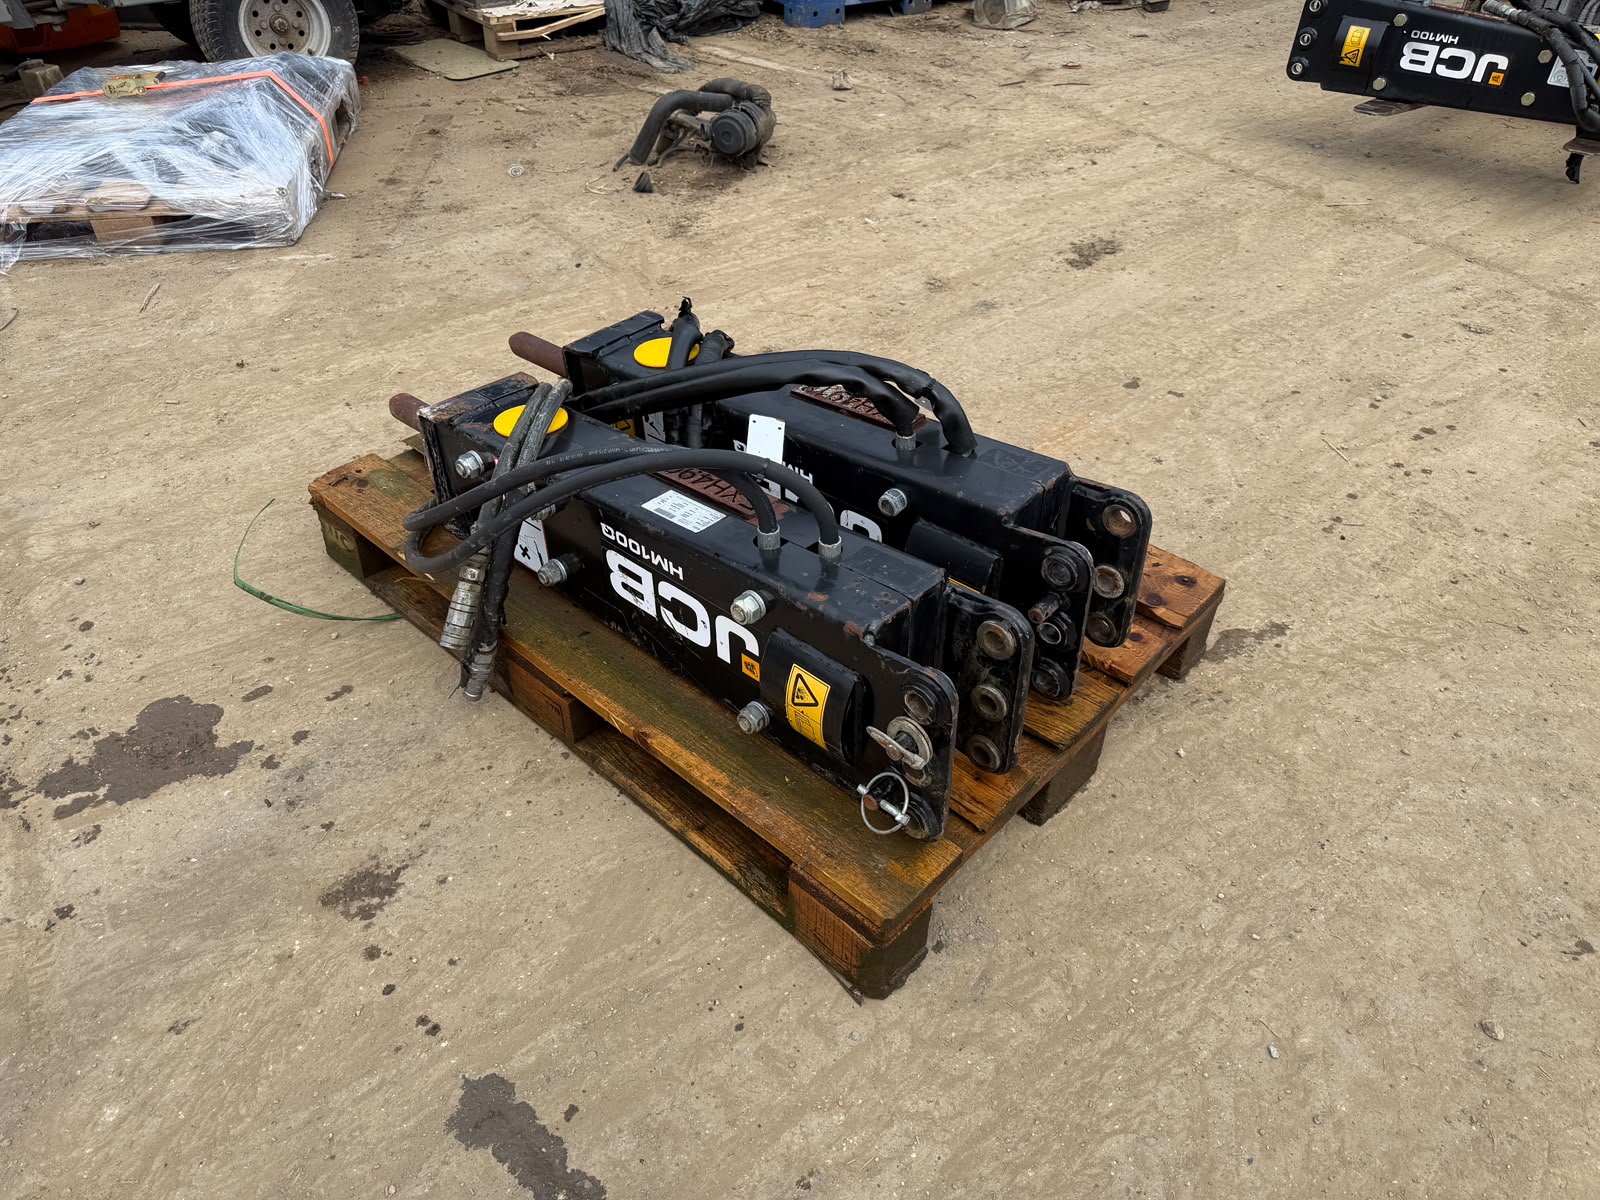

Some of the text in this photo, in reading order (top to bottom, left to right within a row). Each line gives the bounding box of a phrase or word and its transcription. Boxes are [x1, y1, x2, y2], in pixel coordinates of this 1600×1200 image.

[1399, 41, 1509, 83] JCB
[1410, 29, 1459, 45] HM100
[600, 522, 684, 580] HM100Q
[605, 549, 760, 664] JCB
